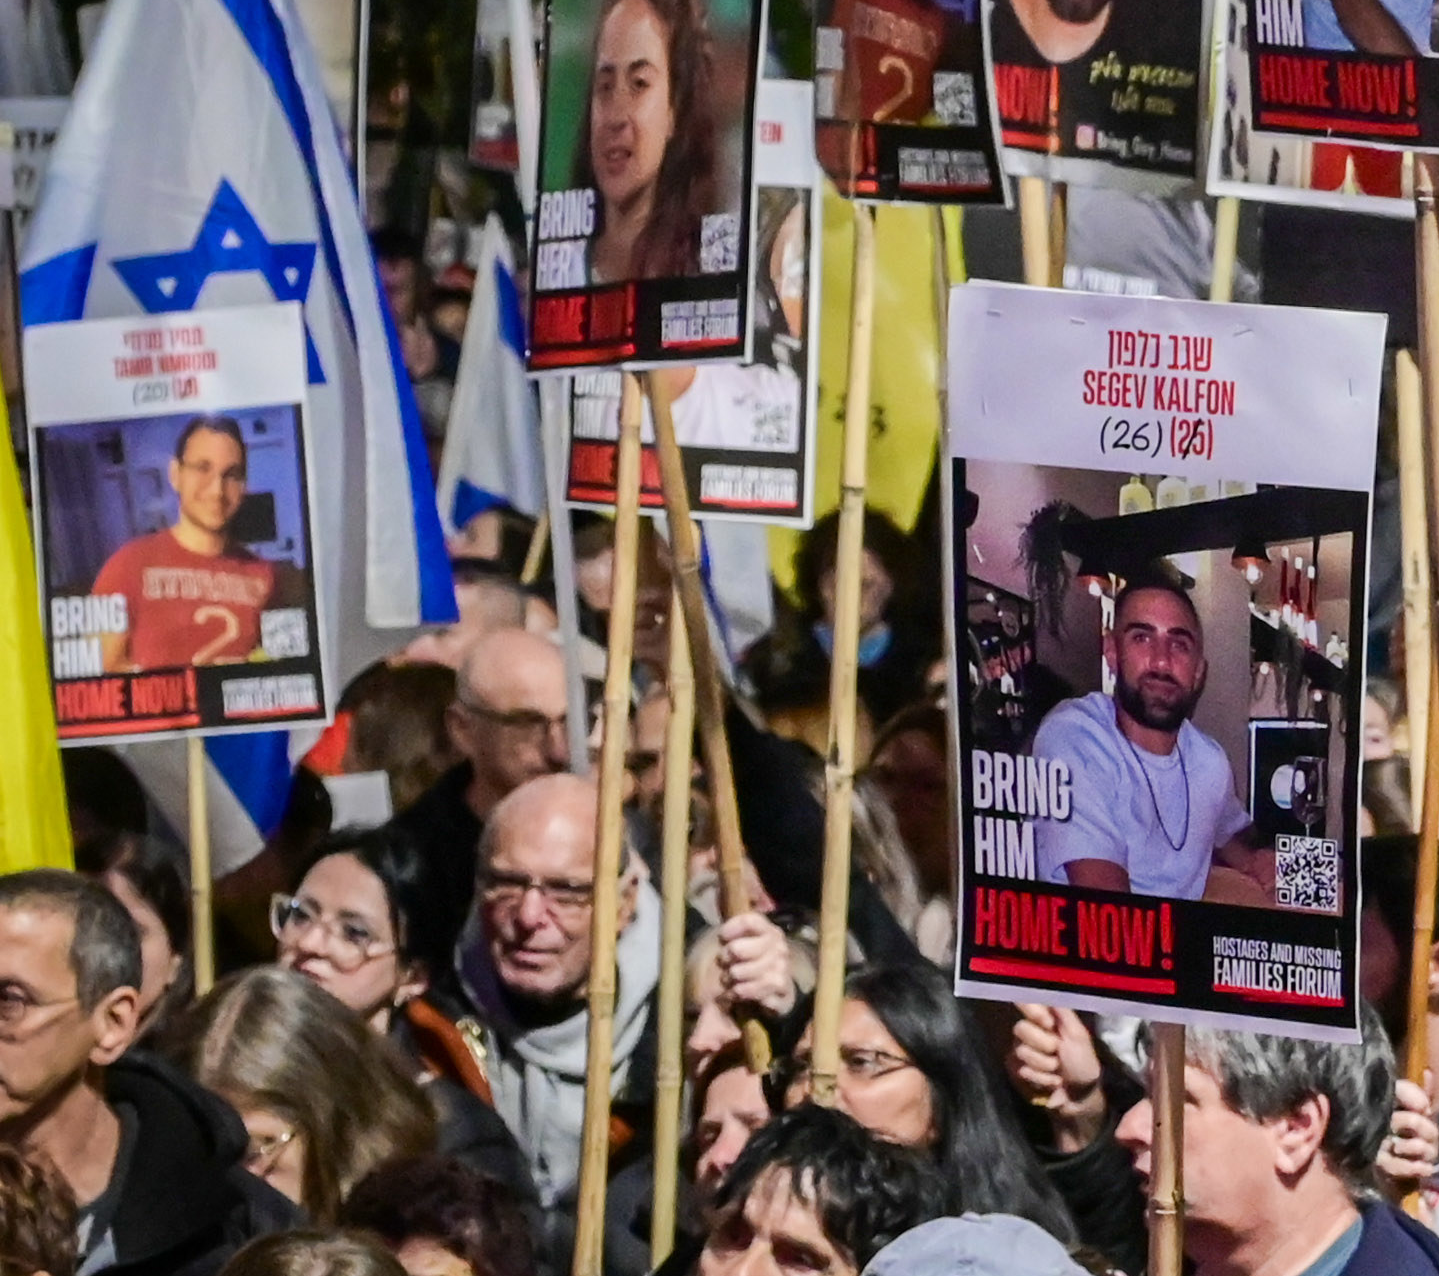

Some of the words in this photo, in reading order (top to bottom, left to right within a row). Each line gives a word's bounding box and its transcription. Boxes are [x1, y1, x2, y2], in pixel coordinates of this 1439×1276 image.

[1107, 329, 1163, 370] כלפון
[1168, 336, 1212, 372] שגב
[1083, 371, 1147, 408] SEGEV
[1154, 376, 1235, 416] KALFON
[51, 593, 128, 637] BRING
[54, 636, 104, 680] HIM
[972, 750, 1073, 820] BRING
[974, 816, 1036, 882] HIM
[974, 887, 1068, 955] HOME
[1077, 902, 1175, 970] NOW!
[1213, 957, 1284, 994] FAMILIES
[1287, 965, 1342, 1000] FORUM
